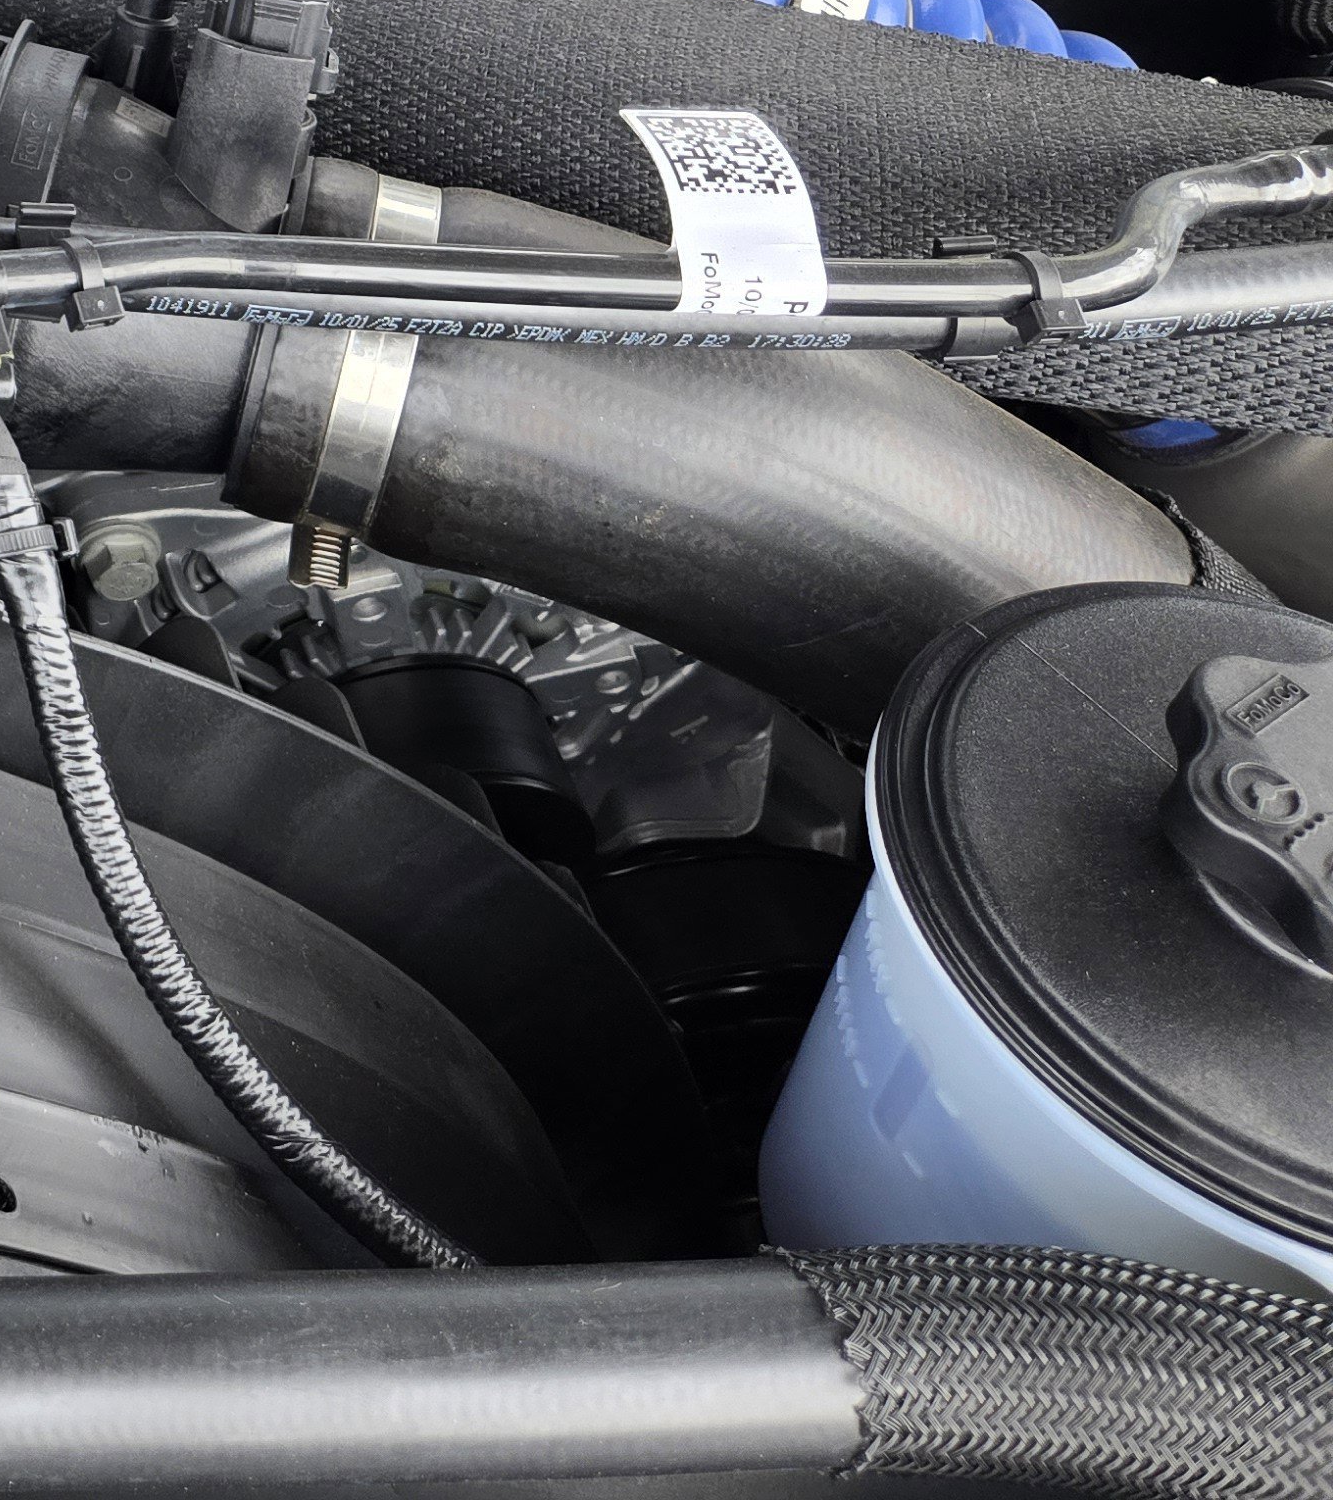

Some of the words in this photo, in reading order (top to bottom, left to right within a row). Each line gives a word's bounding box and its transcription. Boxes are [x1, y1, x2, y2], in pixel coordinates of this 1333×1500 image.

[145, 294, 235, 319] 1041911
[318, 312, 402, 333] 10/01/25
[469, 321, 506, 341] CIP
[578, 328, 615, 347] MEX
[676, 332, 693, 349] B
[699, 332, 730, 350] B2
[747, 333, 852, 351] 17:30:28
[1187, 306, 1280, 331] 10/01/25
[1235, 681, 1301, 730] FoMoCo
